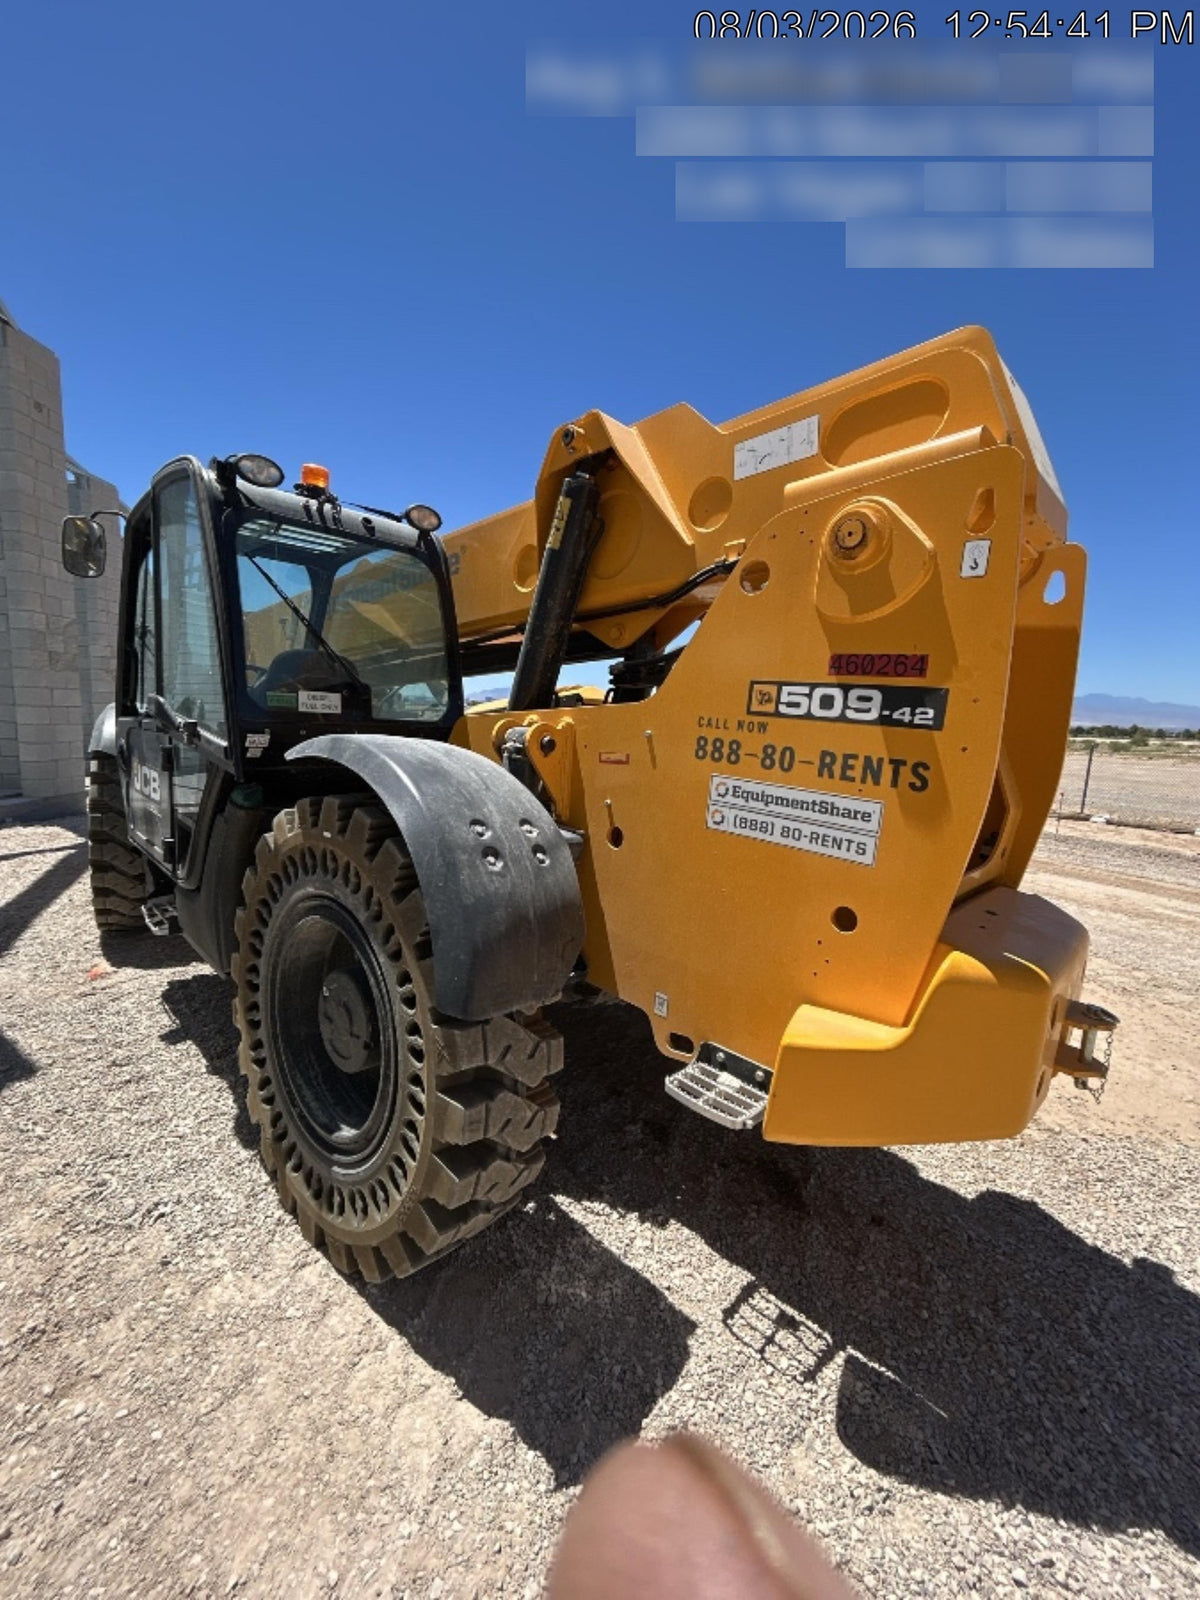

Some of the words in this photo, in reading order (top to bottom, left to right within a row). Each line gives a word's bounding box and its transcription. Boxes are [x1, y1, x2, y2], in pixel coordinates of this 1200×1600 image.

[830, 654, 928, 676] 460264
[778, 685, 935, 725] 509-42
[697, 716, 730, 731] CALL
[736, 719, 769, 734] NOW
[134, 763, 161, 801] JCB
[694, 735, 931, 793] 888-80-RENTS
[731, 785, 873, 823] EquipmentShare
[733, 813, 775, 836] (888)
[780, 828, 867, 856] 80-RENTS
